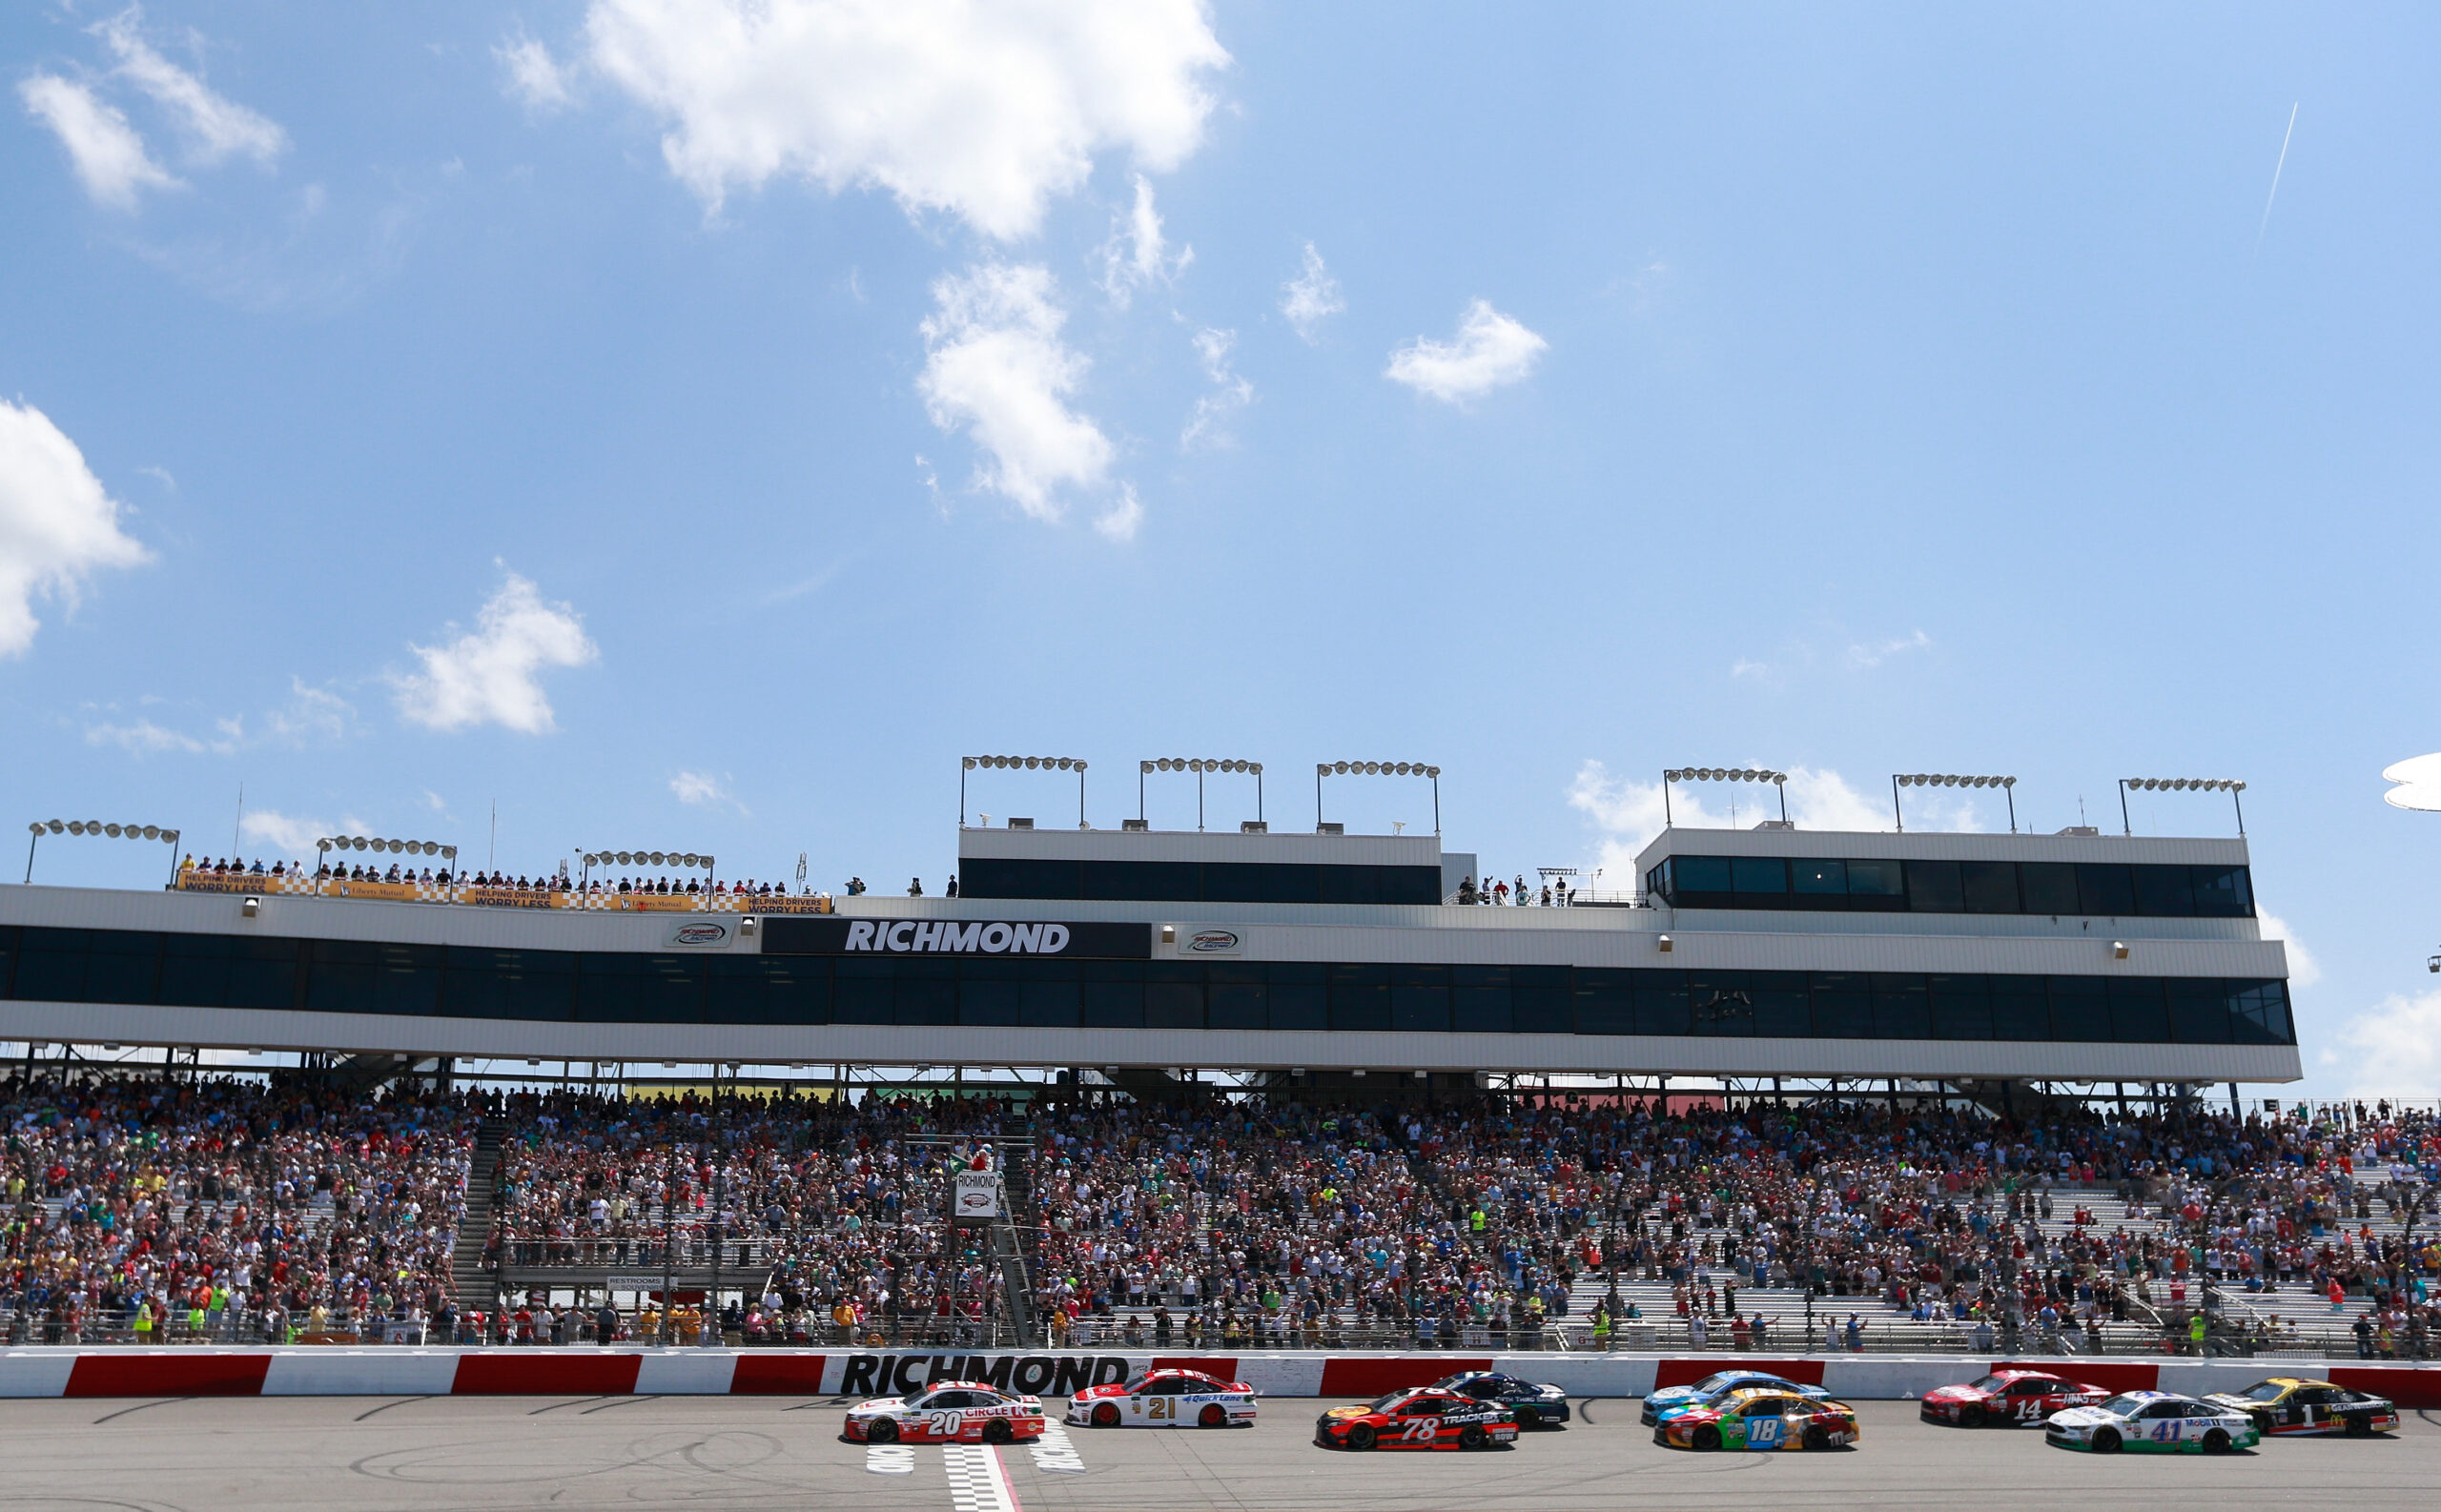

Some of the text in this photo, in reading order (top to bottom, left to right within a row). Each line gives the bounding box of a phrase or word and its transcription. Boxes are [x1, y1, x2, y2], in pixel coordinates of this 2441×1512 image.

[185, 874, 224, 883] HELPING
[185, 882, 265, 894] WORRY LESS
[353, 888, 377, 896] Liberty
[476, 897, 550, 909] WORRY LESS
[845, 921, 1070, 953] RICHMOND
[958, 1175, 995, 1188] RICHMOND
[840, 1356, 1129, 1396] RICHMOND
[1149, 1398, 1175, 1420] 21
[1192, 1395, 1220, 1403] Quick
[2014, 1399, 2042, 1420] 14
[965, 1407, 1008, 1417] CIRCLE
[1442, 1412, 1498, 1424] TRACKER
[2302, 1405, 2315, 1427] 1
[928, 1411, 962, 1436] 20
[1402, 1418, 1439, 1441] 78
[1750, 1419, 1778, 1441] 18
[2151, 1420, 2182, 1443] 41
